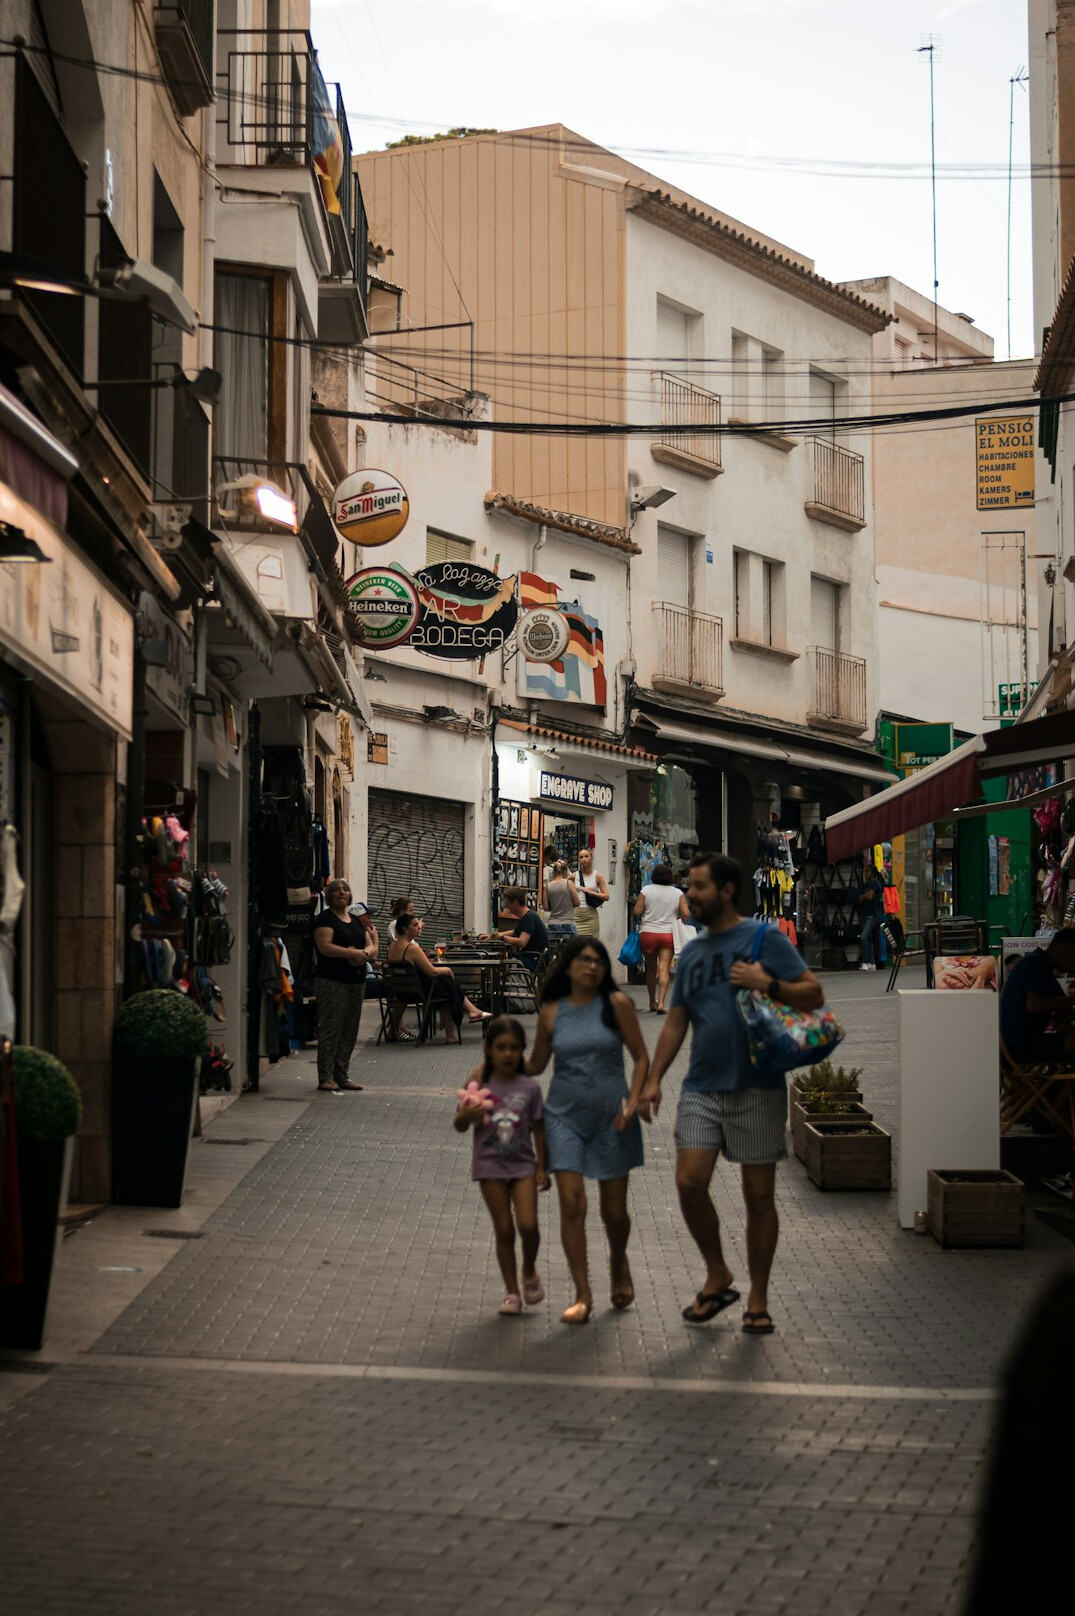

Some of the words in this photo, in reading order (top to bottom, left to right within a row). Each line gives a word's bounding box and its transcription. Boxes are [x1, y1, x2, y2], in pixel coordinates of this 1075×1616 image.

[980, 438, 994, 448] EL
[999, 436, 1033, 448] MOLI
[979, 451, 1034, 461] HABITACIONES
[979, 463, 1016, 472] CHAMBRE
[980, 475, 1001, 484] ROOM
[980, 486, 1011, 494] KAMERS
[980, 497, 1010, 505] ZIMMER
[418, 572, 436, 592] La
[440, 564, 504, 592] Ragazza
[349, 601, 408, 614] Heineken
[423, 597, 461, 622] AR
[410, 626, 504, 647] BODEGA
[541, 774, 586, 802] ENGRAVE
[587, 784, 612, 807] SHOP
[689, 952, 745, 990] GA
